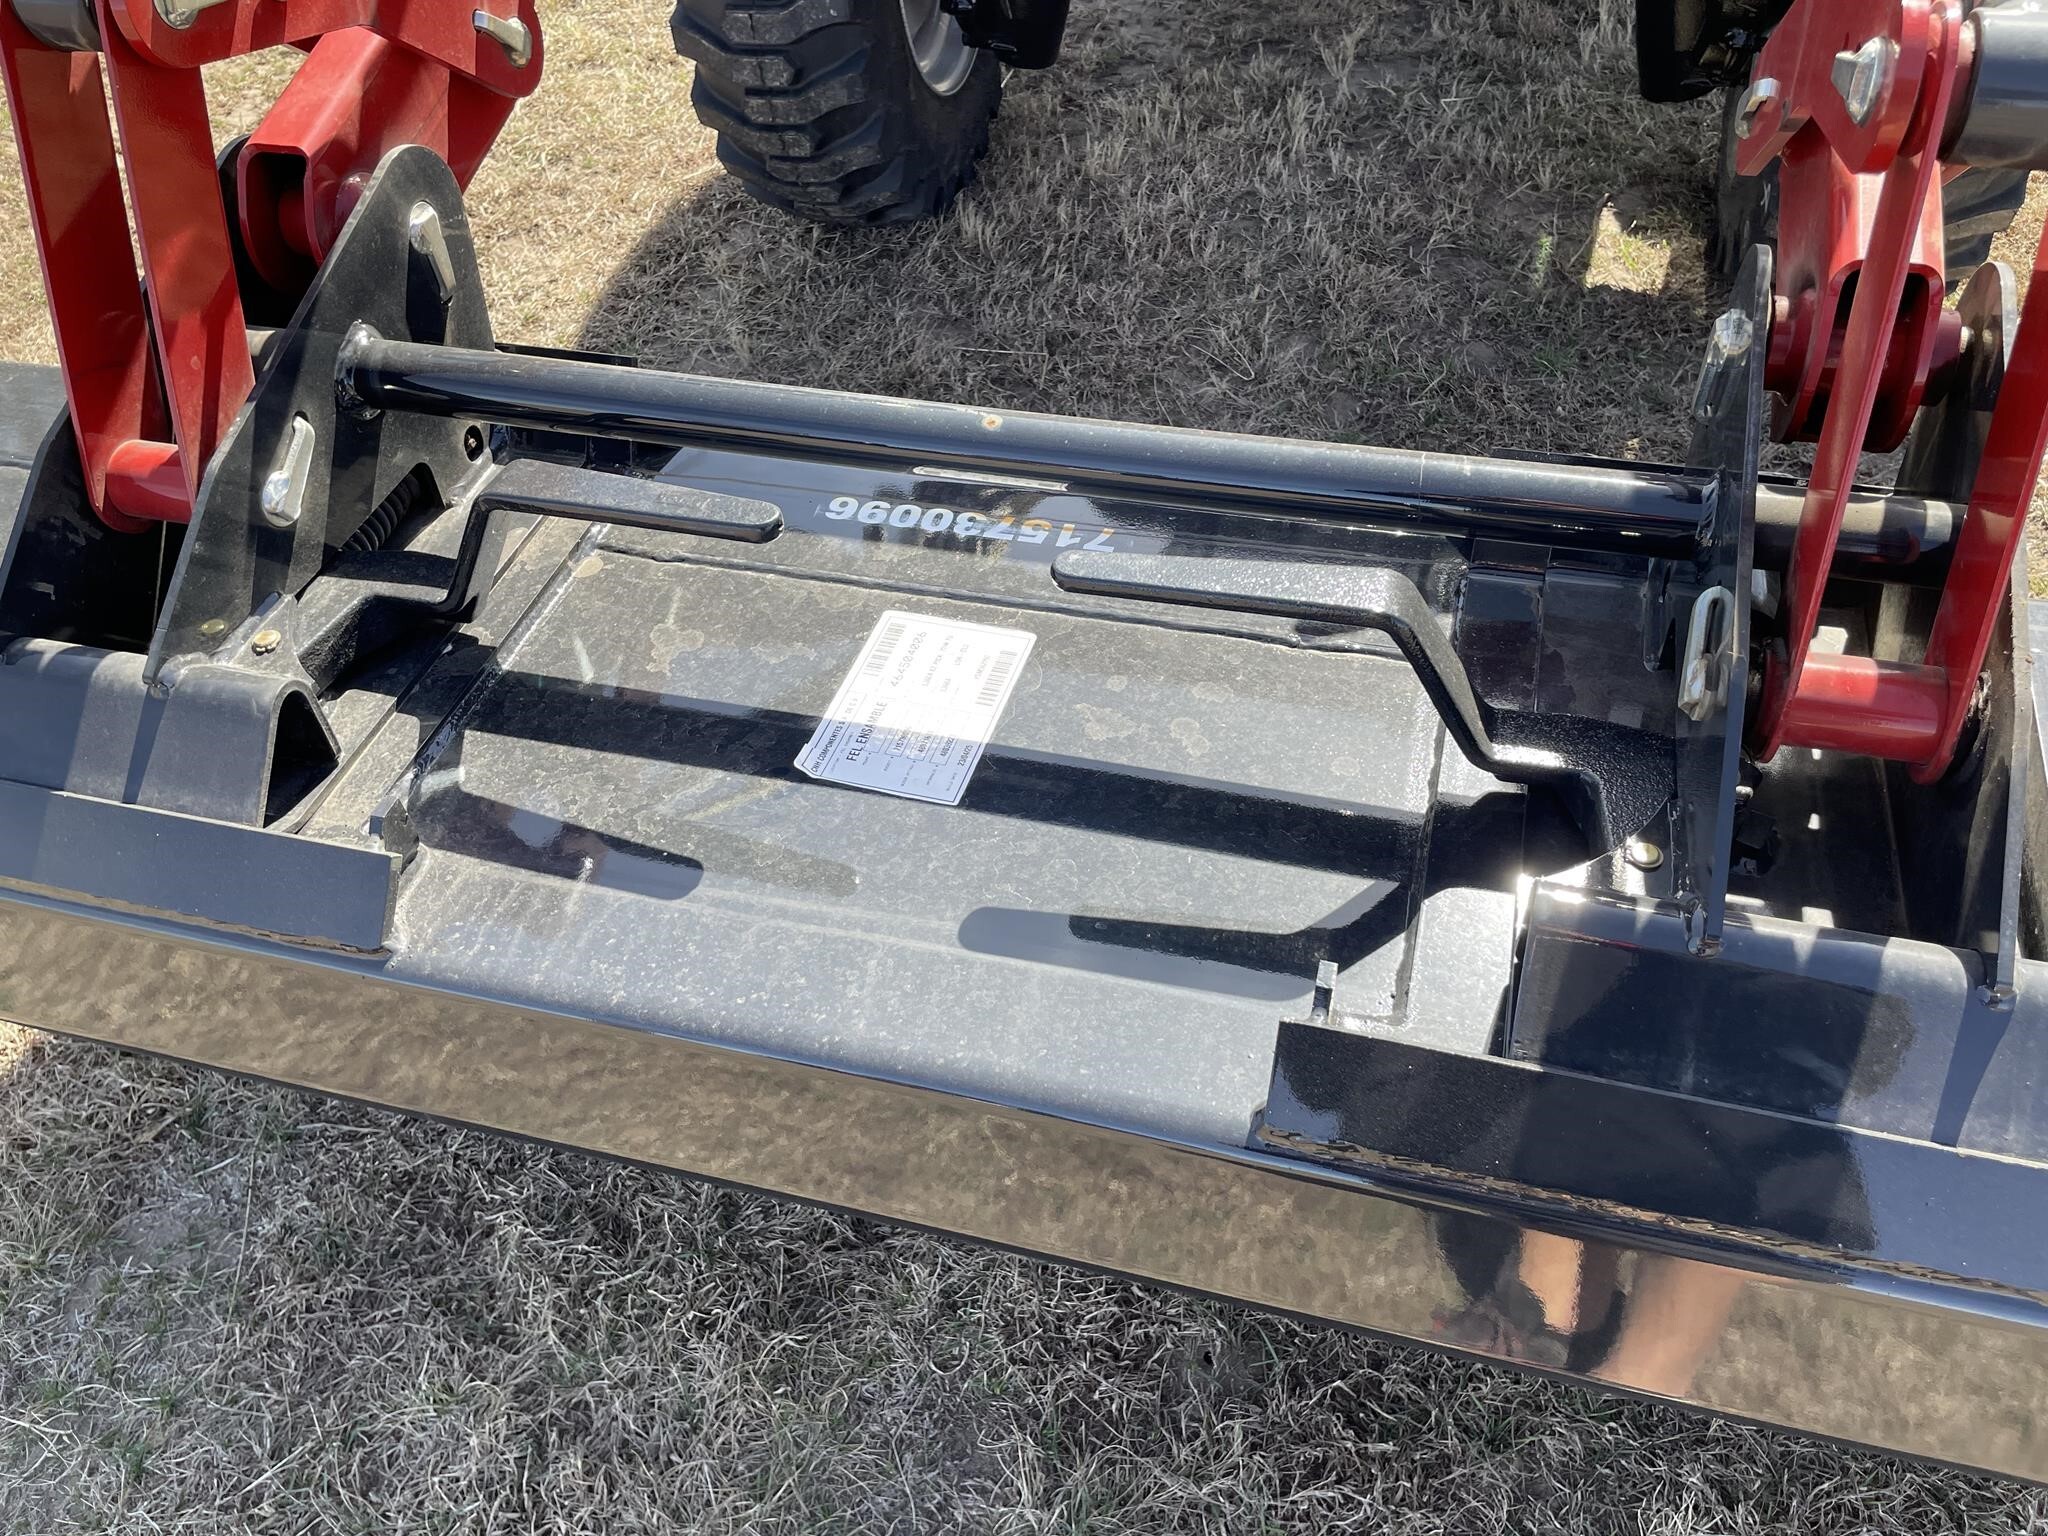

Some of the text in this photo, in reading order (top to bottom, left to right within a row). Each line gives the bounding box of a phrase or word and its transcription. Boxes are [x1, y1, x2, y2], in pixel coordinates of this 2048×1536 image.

[825, 497, 1116, 552] 715730096
[845, 745, 865, 762] FEL
[855, 700, 889, 744] ENSAMBLE
